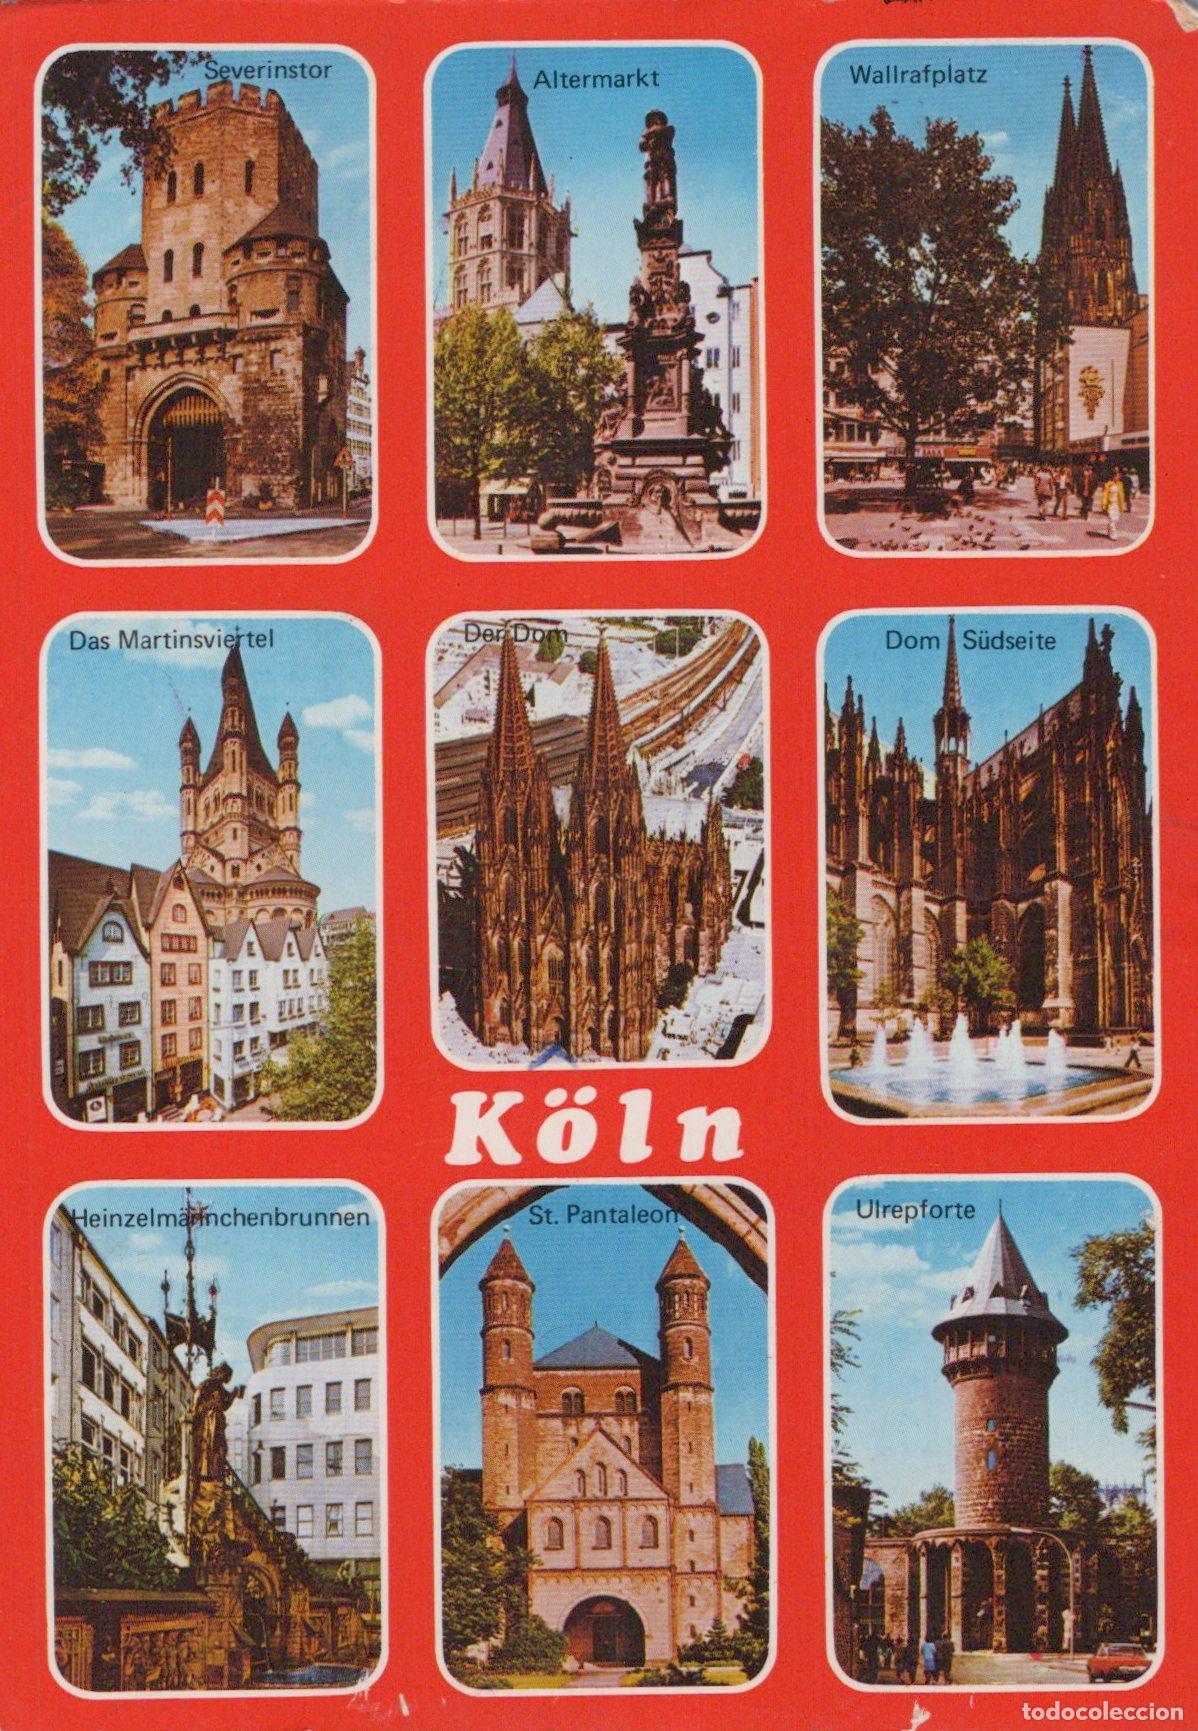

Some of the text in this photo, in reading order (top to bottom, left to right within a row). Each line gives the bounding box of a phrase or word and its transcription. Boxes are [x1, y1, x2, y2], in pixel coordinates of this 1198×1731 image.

[205, 59, 332, 79] Severinstor
[533, 69, 660, 89] Altermarkt
[850, 64, 988, 86] Wallrafplatz
[70, 629, 274, 650] Das Martinsviertel
[464, 624, 568, 643] Der Dom
[886, 631, 1057, 651] Dom Südseite
[445, 1086, 745, 1166] Köln
[72, 1208, 370, 1228] Heinzelmännchenbrunnen
[529, 1204, 679, 1225] St. Pantaleon
[856, 1200, 976, 1223] Ulrepforte
